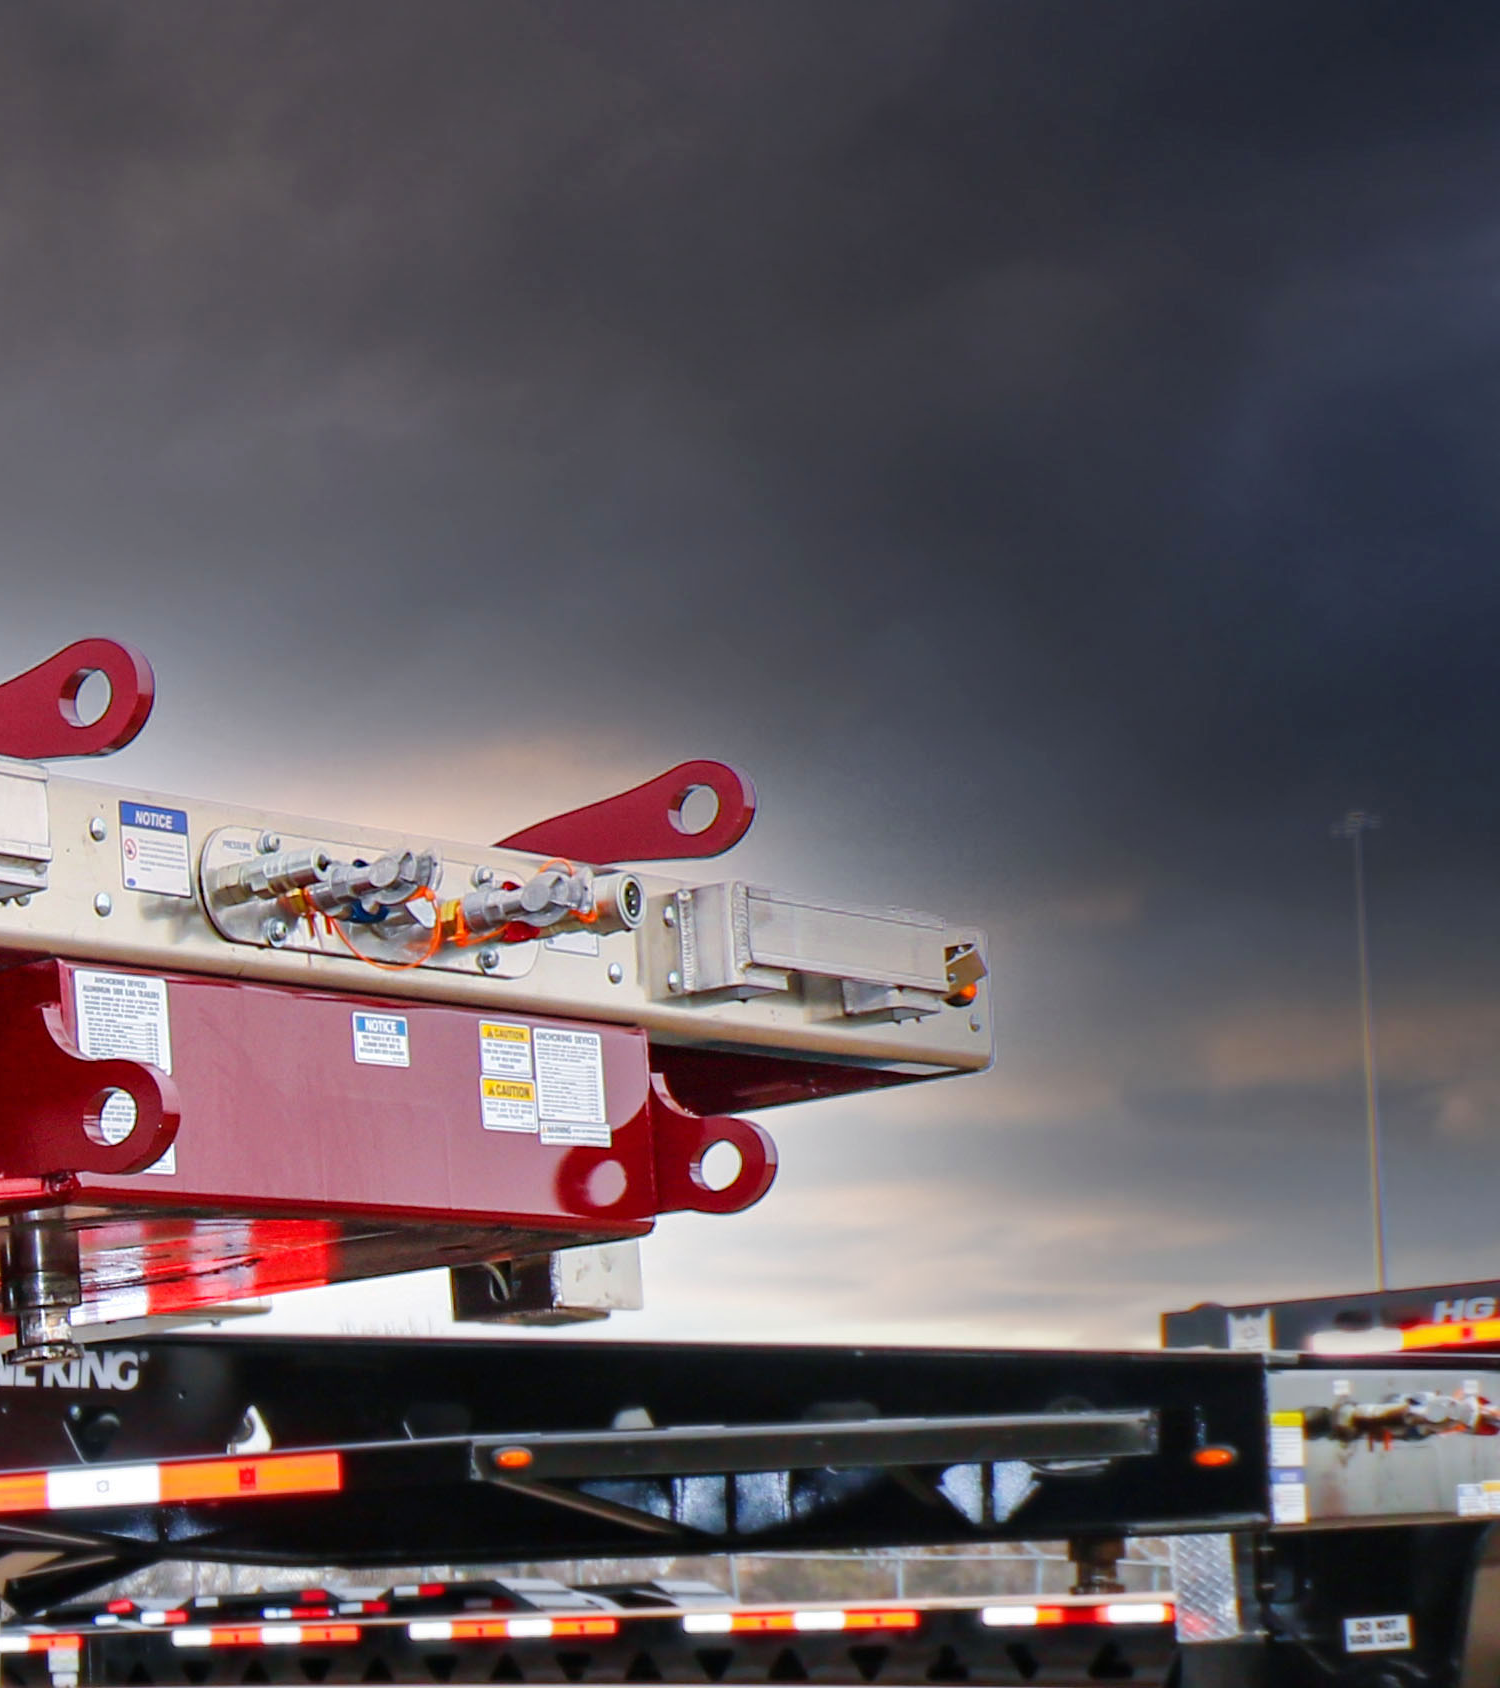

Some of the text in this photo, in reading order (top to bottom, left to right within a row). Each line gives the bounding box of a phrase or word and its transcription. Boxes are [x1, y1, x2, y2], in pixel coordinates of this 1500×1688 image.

[135, 810, 173, 829] NOTICE
[365, 1018, 397, 1033] NOTICE
[494, 1028, 524, 1040] CAUTION
[495, 1084, 530, 1099] CAUTION
[1433, 1296, 1496, 1323] HG
[43, 1351, 140, 1391] KING
[1355, 1619, 1397, 1632] DO NOT
[1349, 1631, 1406, 1644] SIDE LOAD
